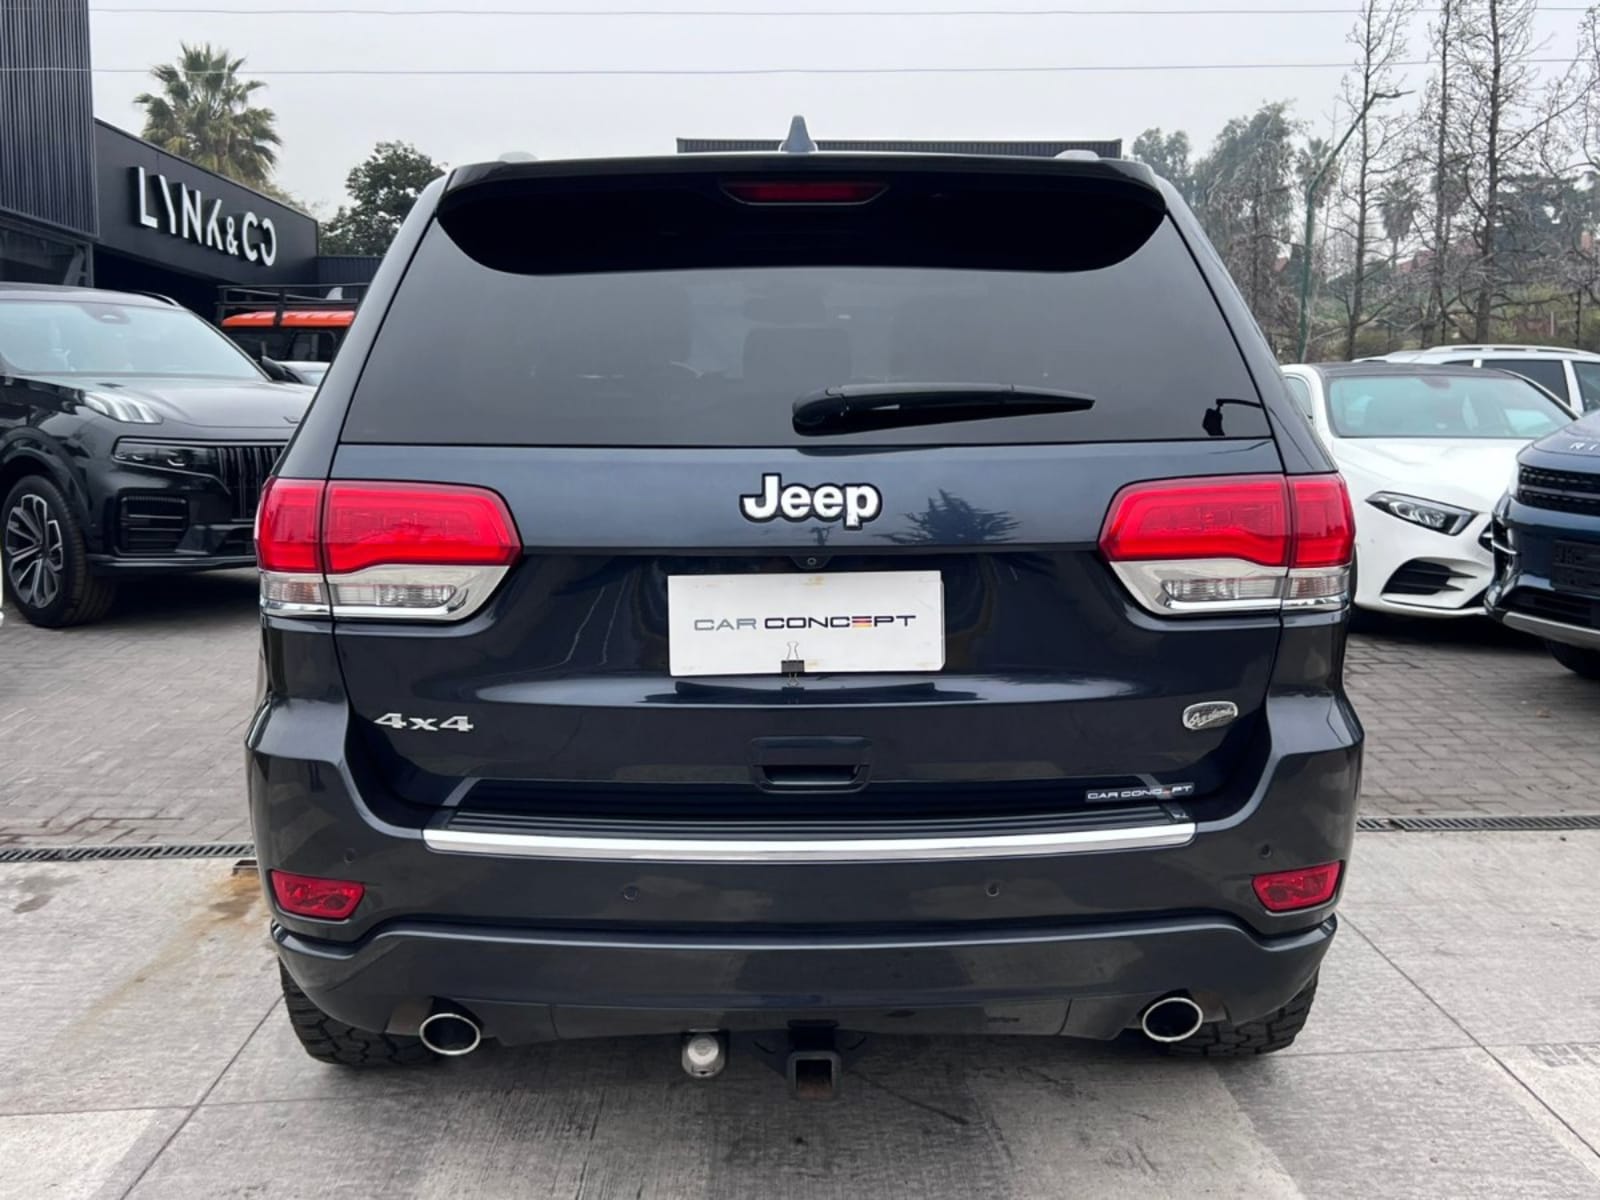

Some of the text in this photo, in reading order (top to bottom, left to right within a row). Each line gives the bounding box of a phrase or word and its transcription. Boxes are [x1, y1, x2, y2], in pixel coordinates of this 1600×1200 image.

[741, 474, 880, 529] Jeep
[694, 614, 917, 632] CAR CONCEPT
[374, 713, 475, 732] 4x4
[1087, 791, 1119, 800] CAR
